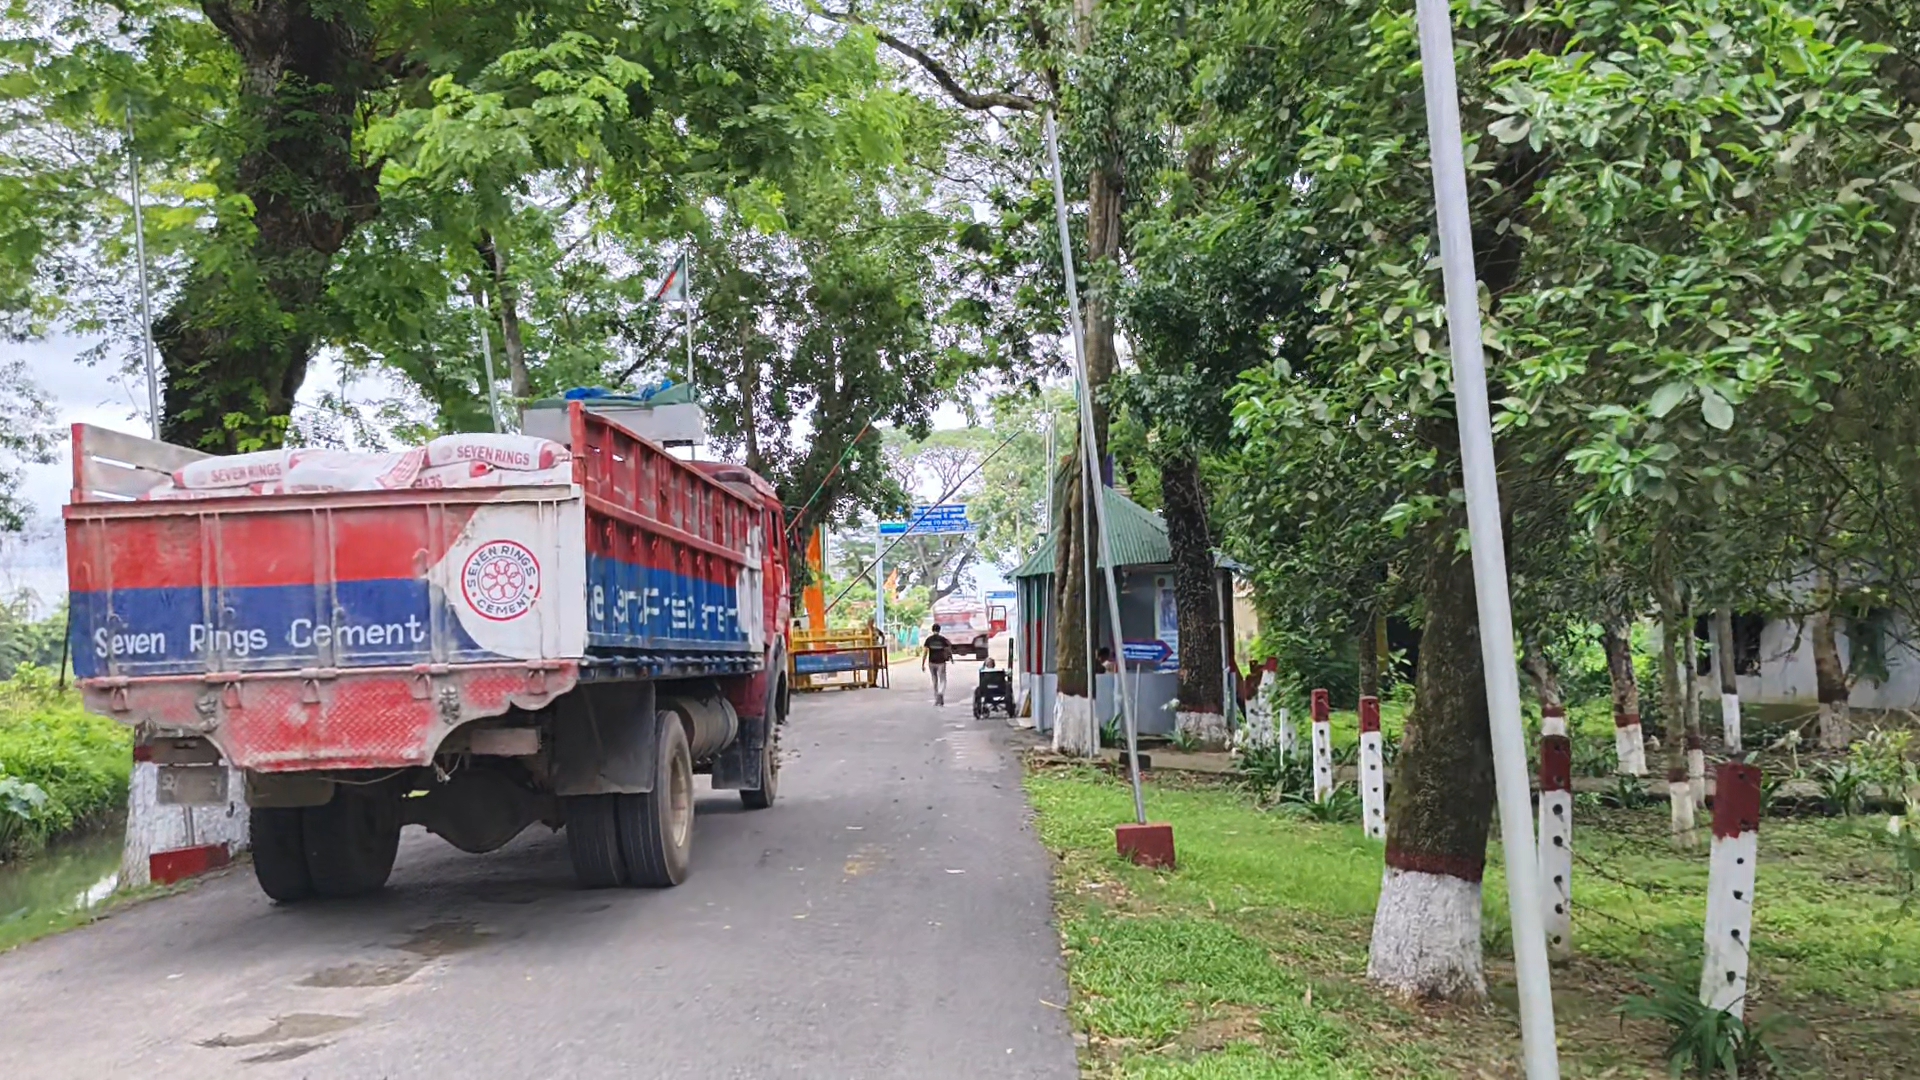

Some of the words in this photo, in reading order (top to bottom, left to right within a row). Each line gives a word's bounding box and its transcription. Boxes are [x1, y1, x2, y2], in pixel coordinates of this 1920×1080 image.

[457, 445, 494, 460] SEVEN
[495, 448, 530, 466] RINGS
[210, 467, 247, 483] SEVEN
[467, 546, 497, 588] SEVEN
[501, 546, 536, 577] RINGS
[477, 593, 530, 615] CEMENT
[94, 627, 165, 658] Seven
[189, 623, 268, 657] Rings
[291, 614, 425, 648] Cement
